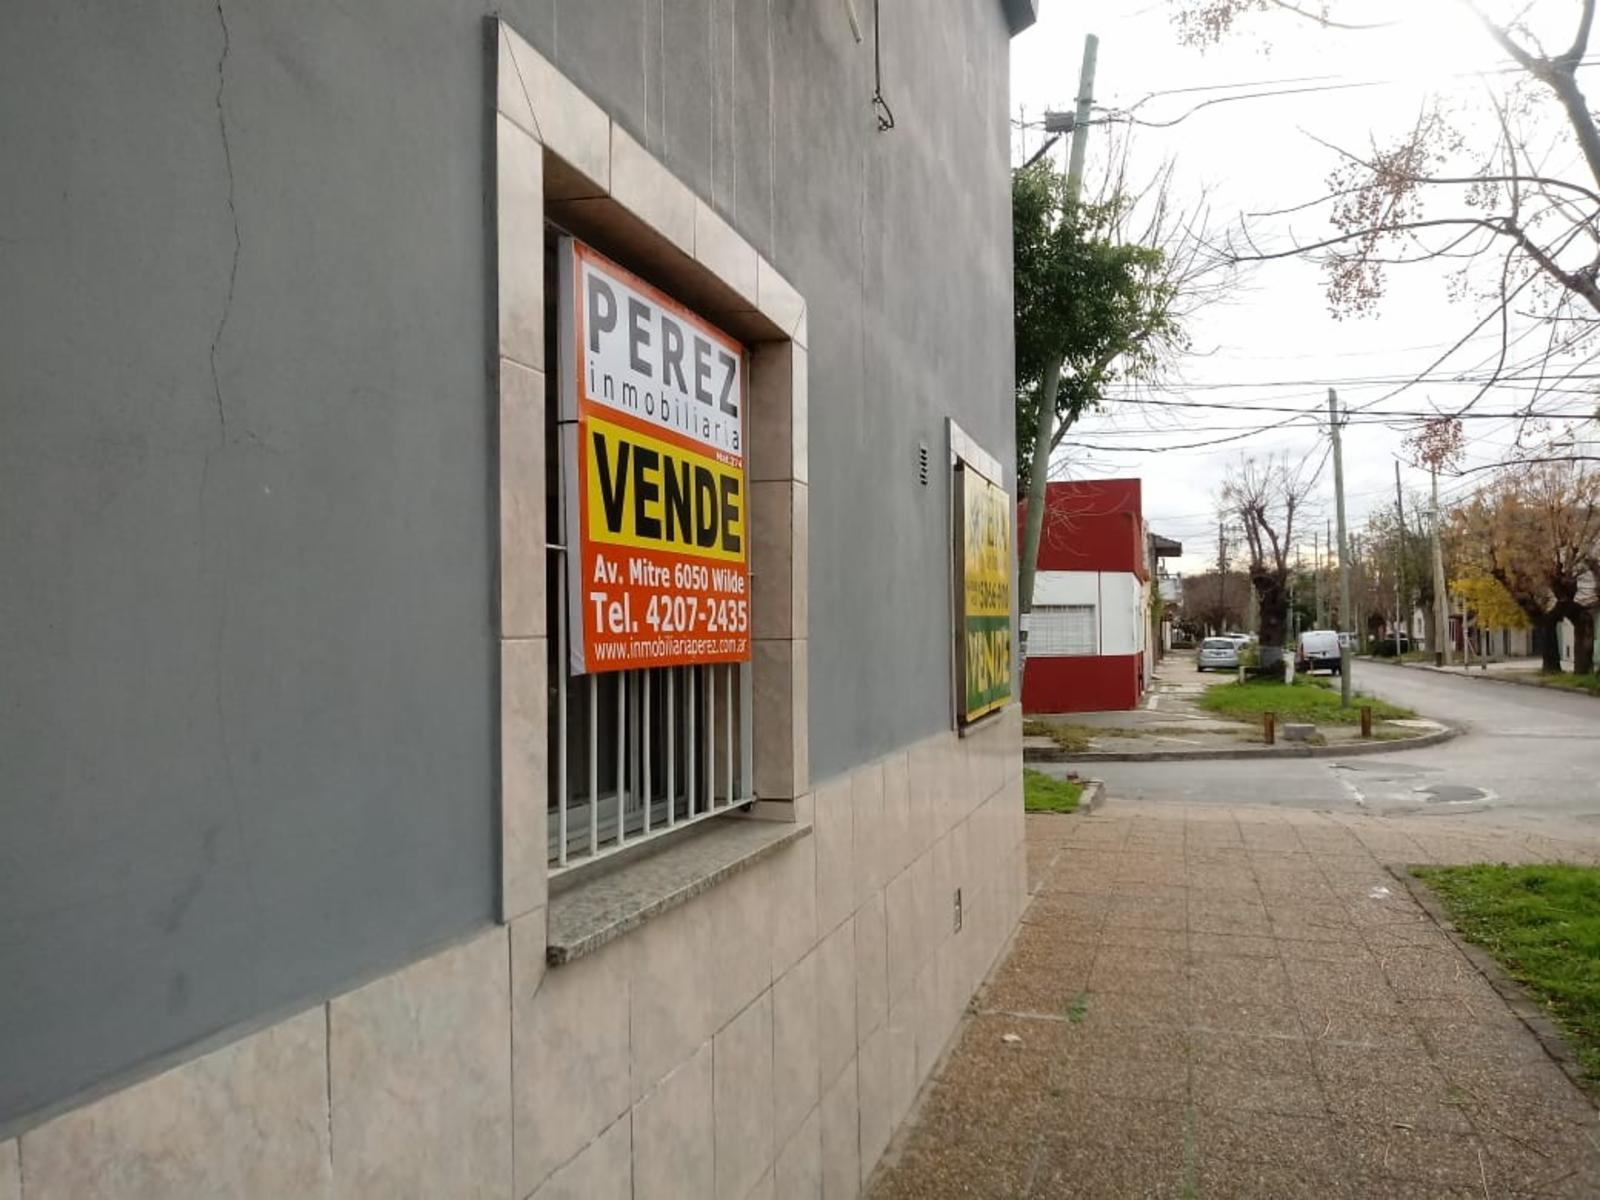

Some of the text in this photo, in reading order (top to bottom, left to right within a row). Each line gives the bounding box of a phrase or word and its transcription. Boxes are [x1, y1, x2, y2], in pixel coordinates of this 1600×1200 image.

[588, 272, 738, 419] PEREZ
[590, 360, 739, 450] inmobiliaria
[592, 431, 741, 554] VENDE
[593, 553, 745, 594] Av. Mitre 6050 Wilde
[590, 591, 748, 633] Tel. 4207-2435
[594, 634, 748, 662] www.inmobiliariaperez.com.ar
